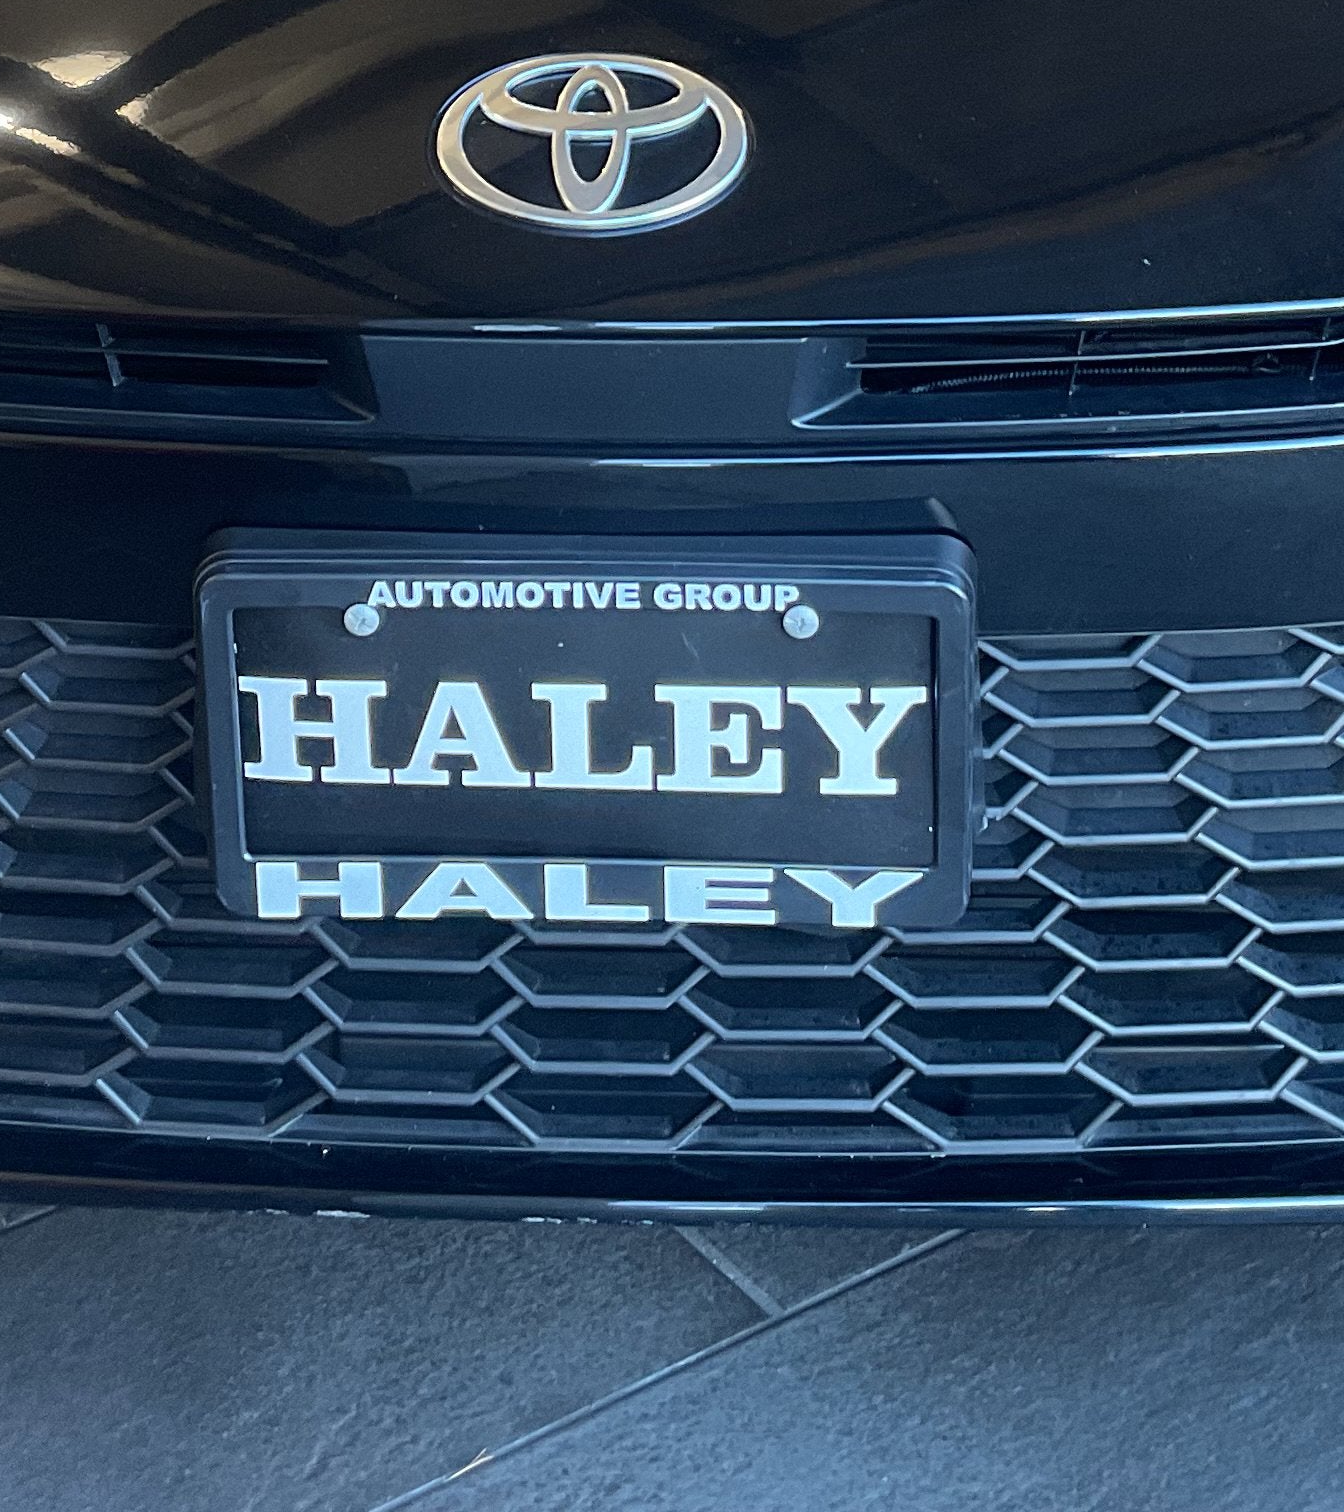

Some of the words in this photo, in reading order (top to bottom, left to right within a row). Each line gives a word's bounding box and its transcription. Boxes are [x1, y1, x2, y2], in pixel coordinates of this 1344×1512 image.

[367, 580, 641, 609] AUTOMOTIVE
[653, 582, 800, 612] GROUP
[238, 675, 927, 796] HALEY
[257, 861, 925, 928] HALEY
